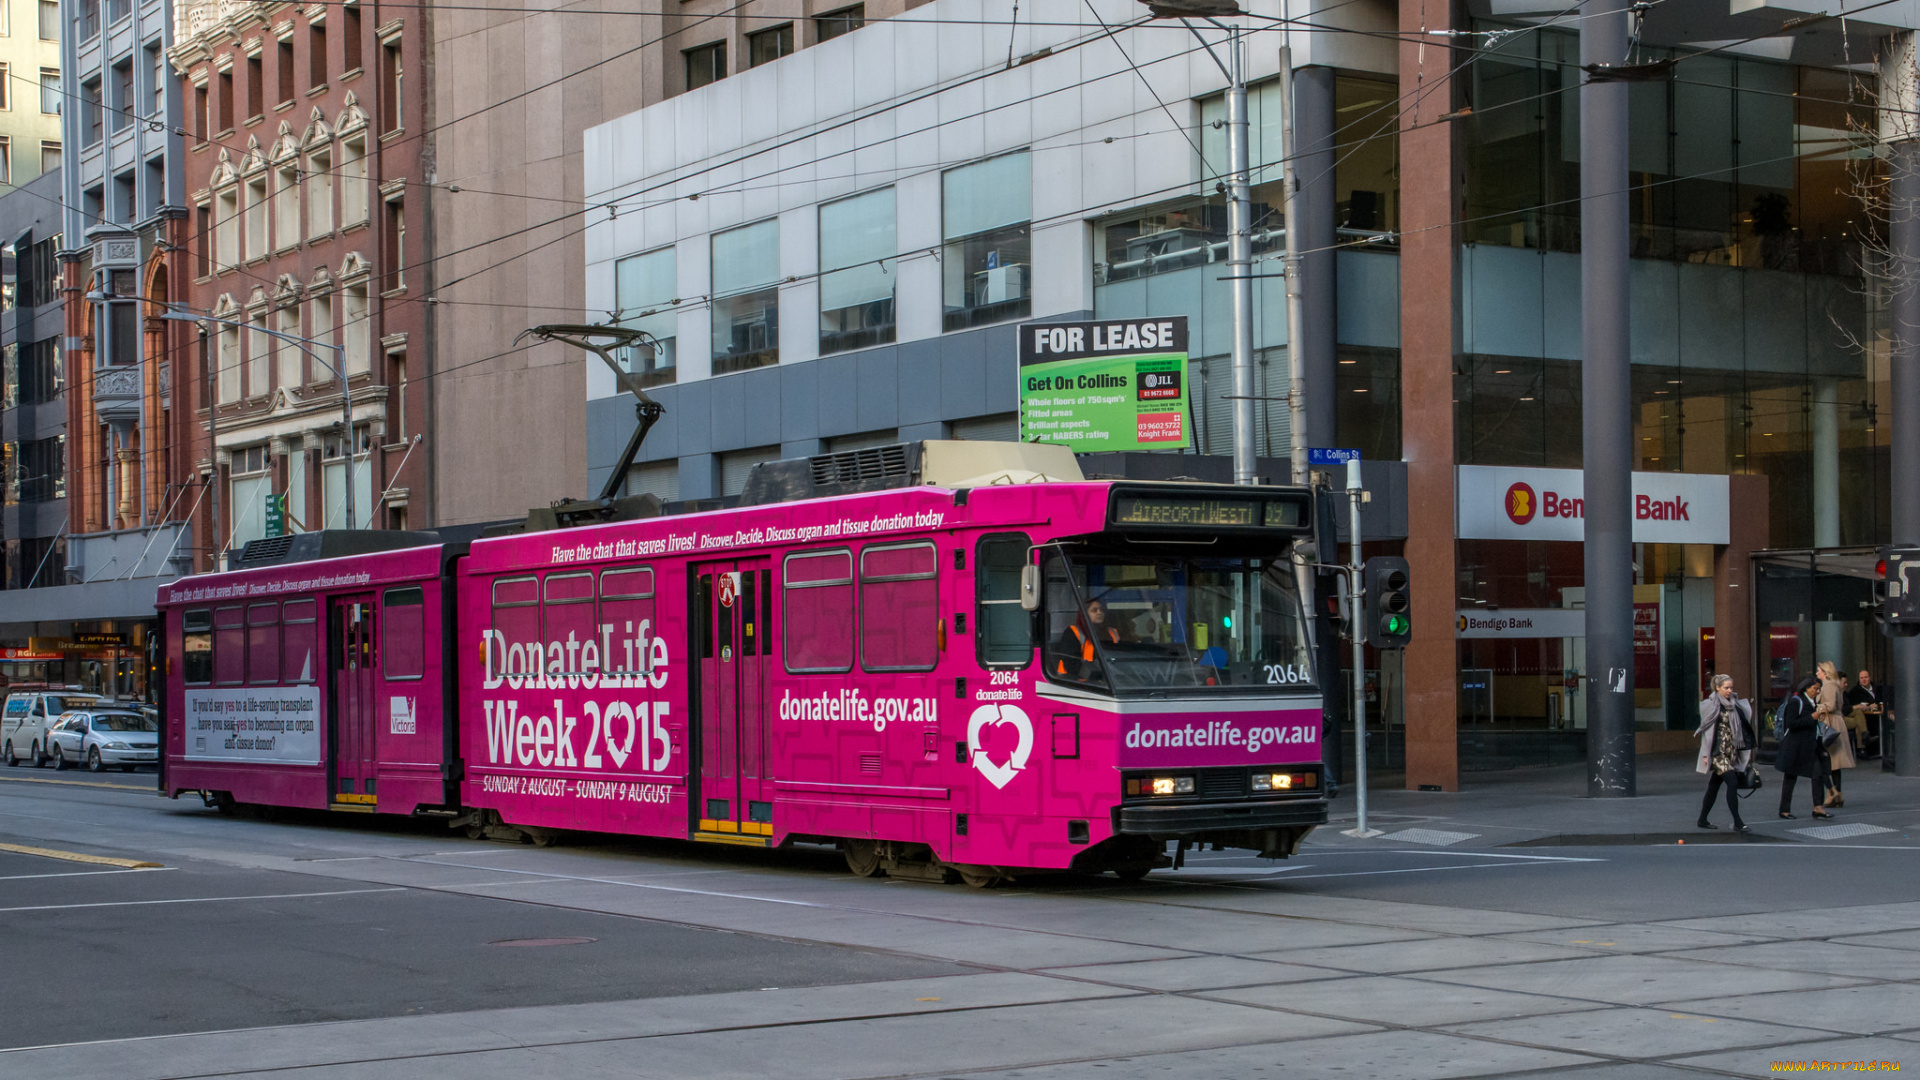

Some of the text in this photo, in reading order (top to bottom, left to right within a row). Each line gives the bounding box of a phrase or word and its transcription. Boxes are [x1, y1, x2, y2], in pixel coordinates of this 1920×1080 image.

[1035, 322, 1173, 353] FOR LEASE
[1027, 374, 1127, 391] Get On Collins
[1157, 375, 1173, 385] JLL
[1027, 398, 1051, 406] Whole
[1053, 397, 1075, 406] floors
[1077, 396, 1086, 404] of
[1028, 409, 1073, 418] Fitted areas
[1028, 420, 1090, 429] Brilliant aspects
[1164, 421, 1181, 429] 5722
[1053, 431, 1084, 440] NABERS
[1086, 430, 1109, 439] rating
[1138, 428, 1181, 439] Knight Frank
[1326, 450, 1359, 459] Collins St
[1636, 494, 1690, 521] Bank
[551, 509, 944, 563] Have the chat that saves lives! Discover, Decide, Discuss organ and tissue donation today
[170, 590, 183, 602] Have
[183, 588, 193, 601] the
[193, 587, 204, 600] chat
[205, 586, 216, 598] that
[216, 586, 231, 598] saves
[232, 582, 248, 596] lives!
[282, 580, 298, 591] Discuss
[298, 579, 311, 591] organ
[311, 576, 321, 588] and
[321, 575, 334, 587] tissue
[335, 573, 355, 585] donation
[356, 571, 370, 585] today
[720, 578, 732, 588] STOP
[1470, 618, 1533, 631] Bendigo Bank
[482, 618, 669, 690] DonateLife
[990, 672, 1019, 685] 2064
[1263, 664, 1311, 684] 2064
[192, 697, 313, 715] If you'd say yes to a life-saving transplant
[779, 688, 938, 732] donatelife.gov.au
[198, 717, 211, 730] have
[212, 720, 222, 733] you
[237, 719, 247, 733] yes
[248, 718, 254, 730] to
[255, 717, 284, 734] becoming
[286, 719, 294, 731] an
[295, 719, 314, 734] organ
[392, 717, 415, 733] Victoria
[483, 699, 577, 767] Week
[225, 736, 276, 750] and tissue donor?
[1126, 721, 1316, 752] donatelife.gov.au
[483, 775, 520, 794] SUNDAY
[521, 778, 527, 795] 2
[528, 778, 567, 797] AUGUST
[576, 780, 618, 800] SUNDAY
[619, 782, 627, 801] 9
[628, 783, 673, 804] AUGUST
